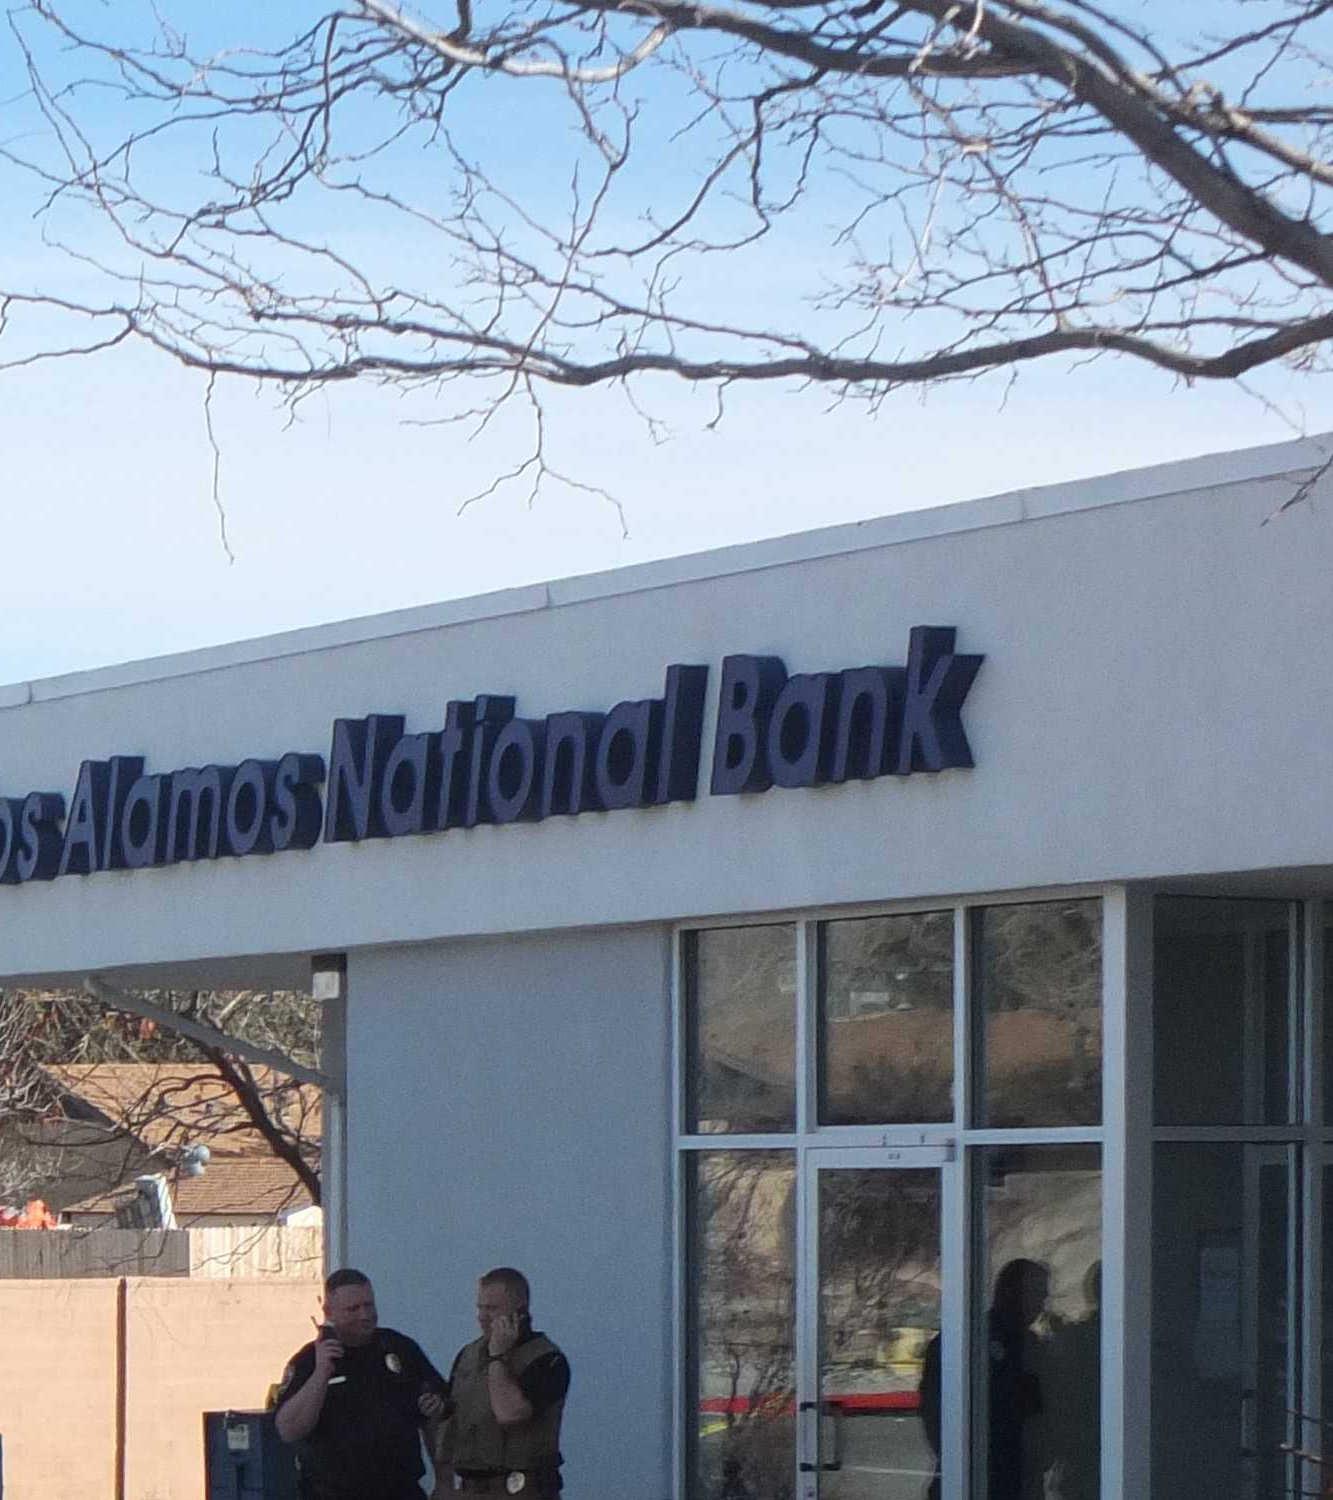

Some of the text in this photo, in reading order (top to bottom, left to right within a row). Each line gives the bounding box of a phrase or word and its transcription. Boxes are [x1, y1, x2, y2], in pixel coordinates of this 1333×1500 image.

[59, 755, 324, 875] Alamos
[323, 664, 710, 844] National
[710, 625, 986, 796] Bank
